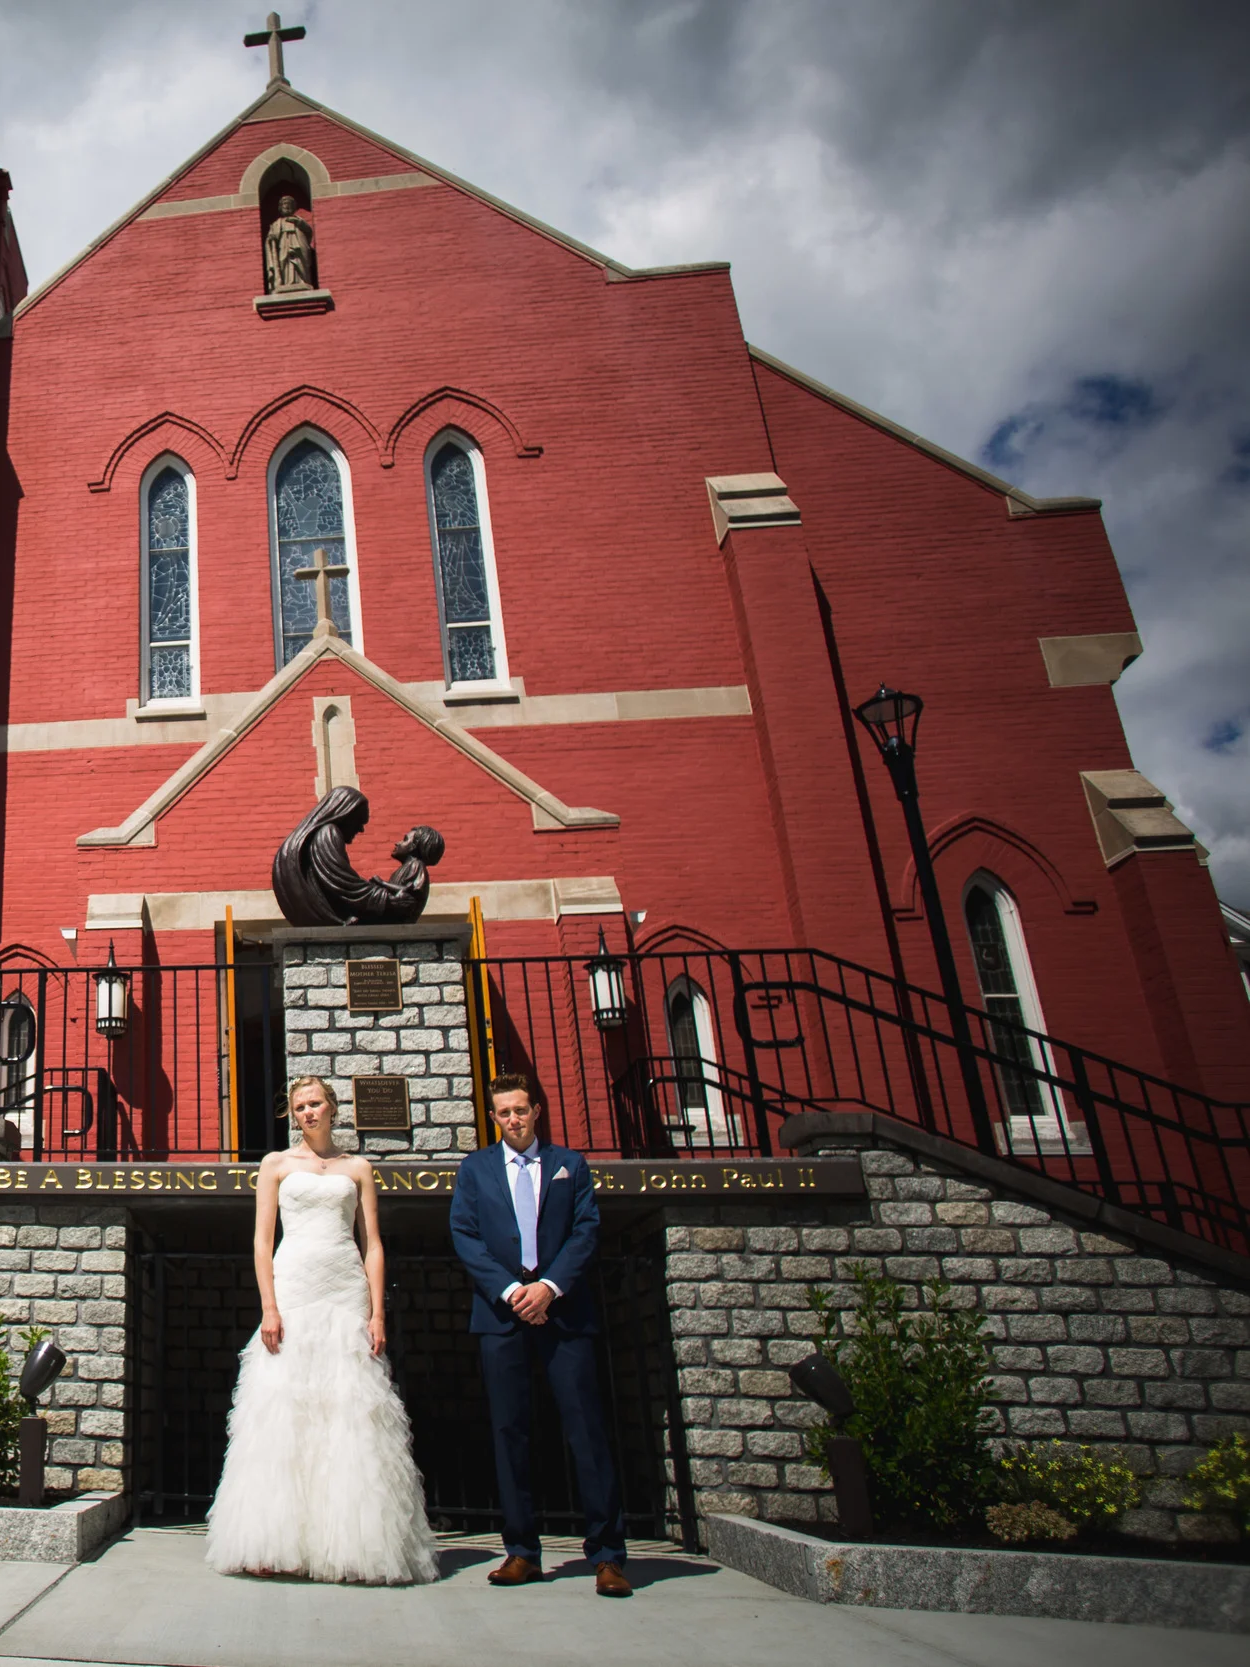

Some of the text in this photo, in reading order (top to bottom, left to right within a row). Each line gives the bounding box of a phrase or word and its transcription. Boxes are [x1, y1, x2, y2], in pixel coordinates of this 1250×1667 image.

[40, 1169, 63, 1189] A
[74, 1168, 218, 1190] BLESSING
[373, 1169, 456, 1190] ANOT
[639, 1168, 707, 1192] John
[722, 1168, 784, 1188] Paul
[799, 1168, 816, 1188] II
